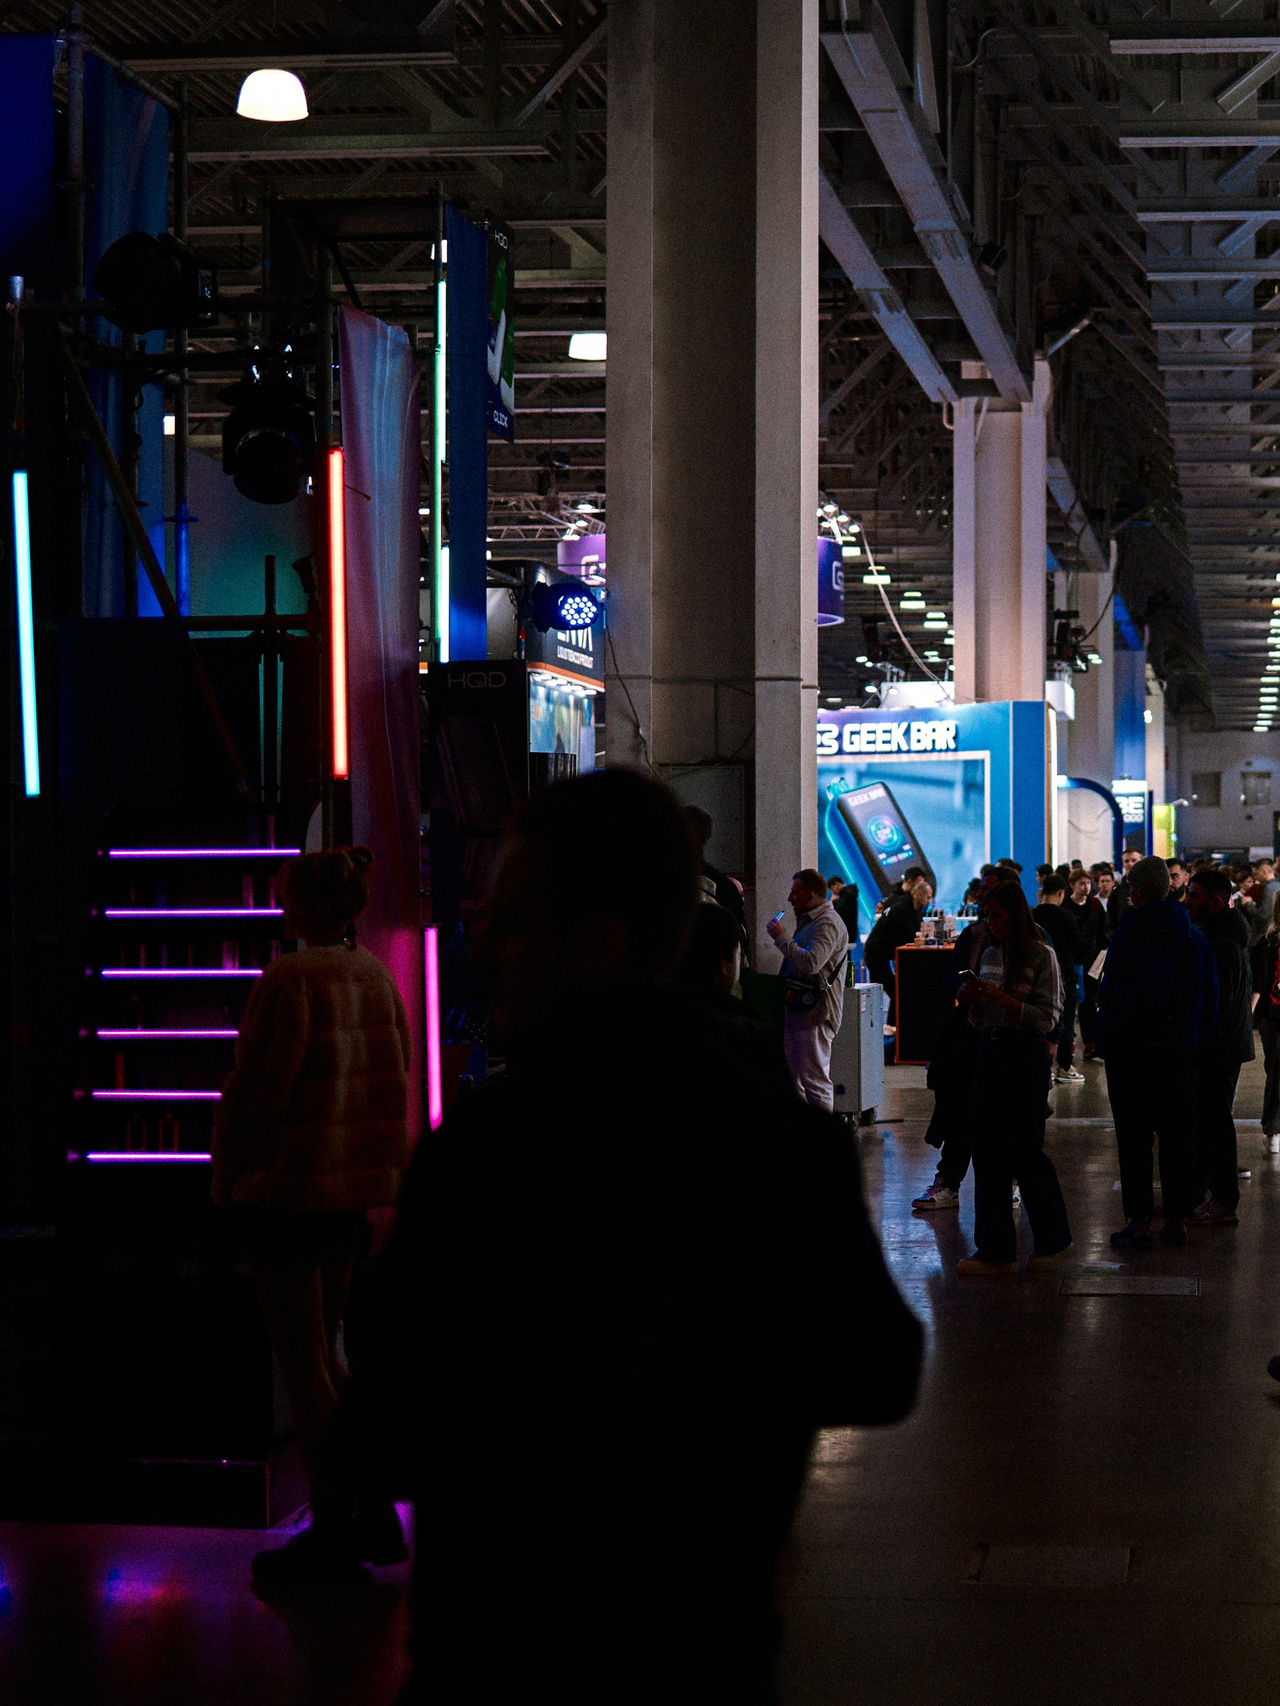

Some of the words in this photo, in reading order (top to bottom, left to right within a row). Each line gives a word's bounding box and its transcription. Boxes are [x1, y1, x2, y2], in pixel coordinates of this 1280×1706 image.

[447, 671, 507, 689] HQD
[842, 722, 909, 753] GEEK
[910, 720, 957, 751] BAR
